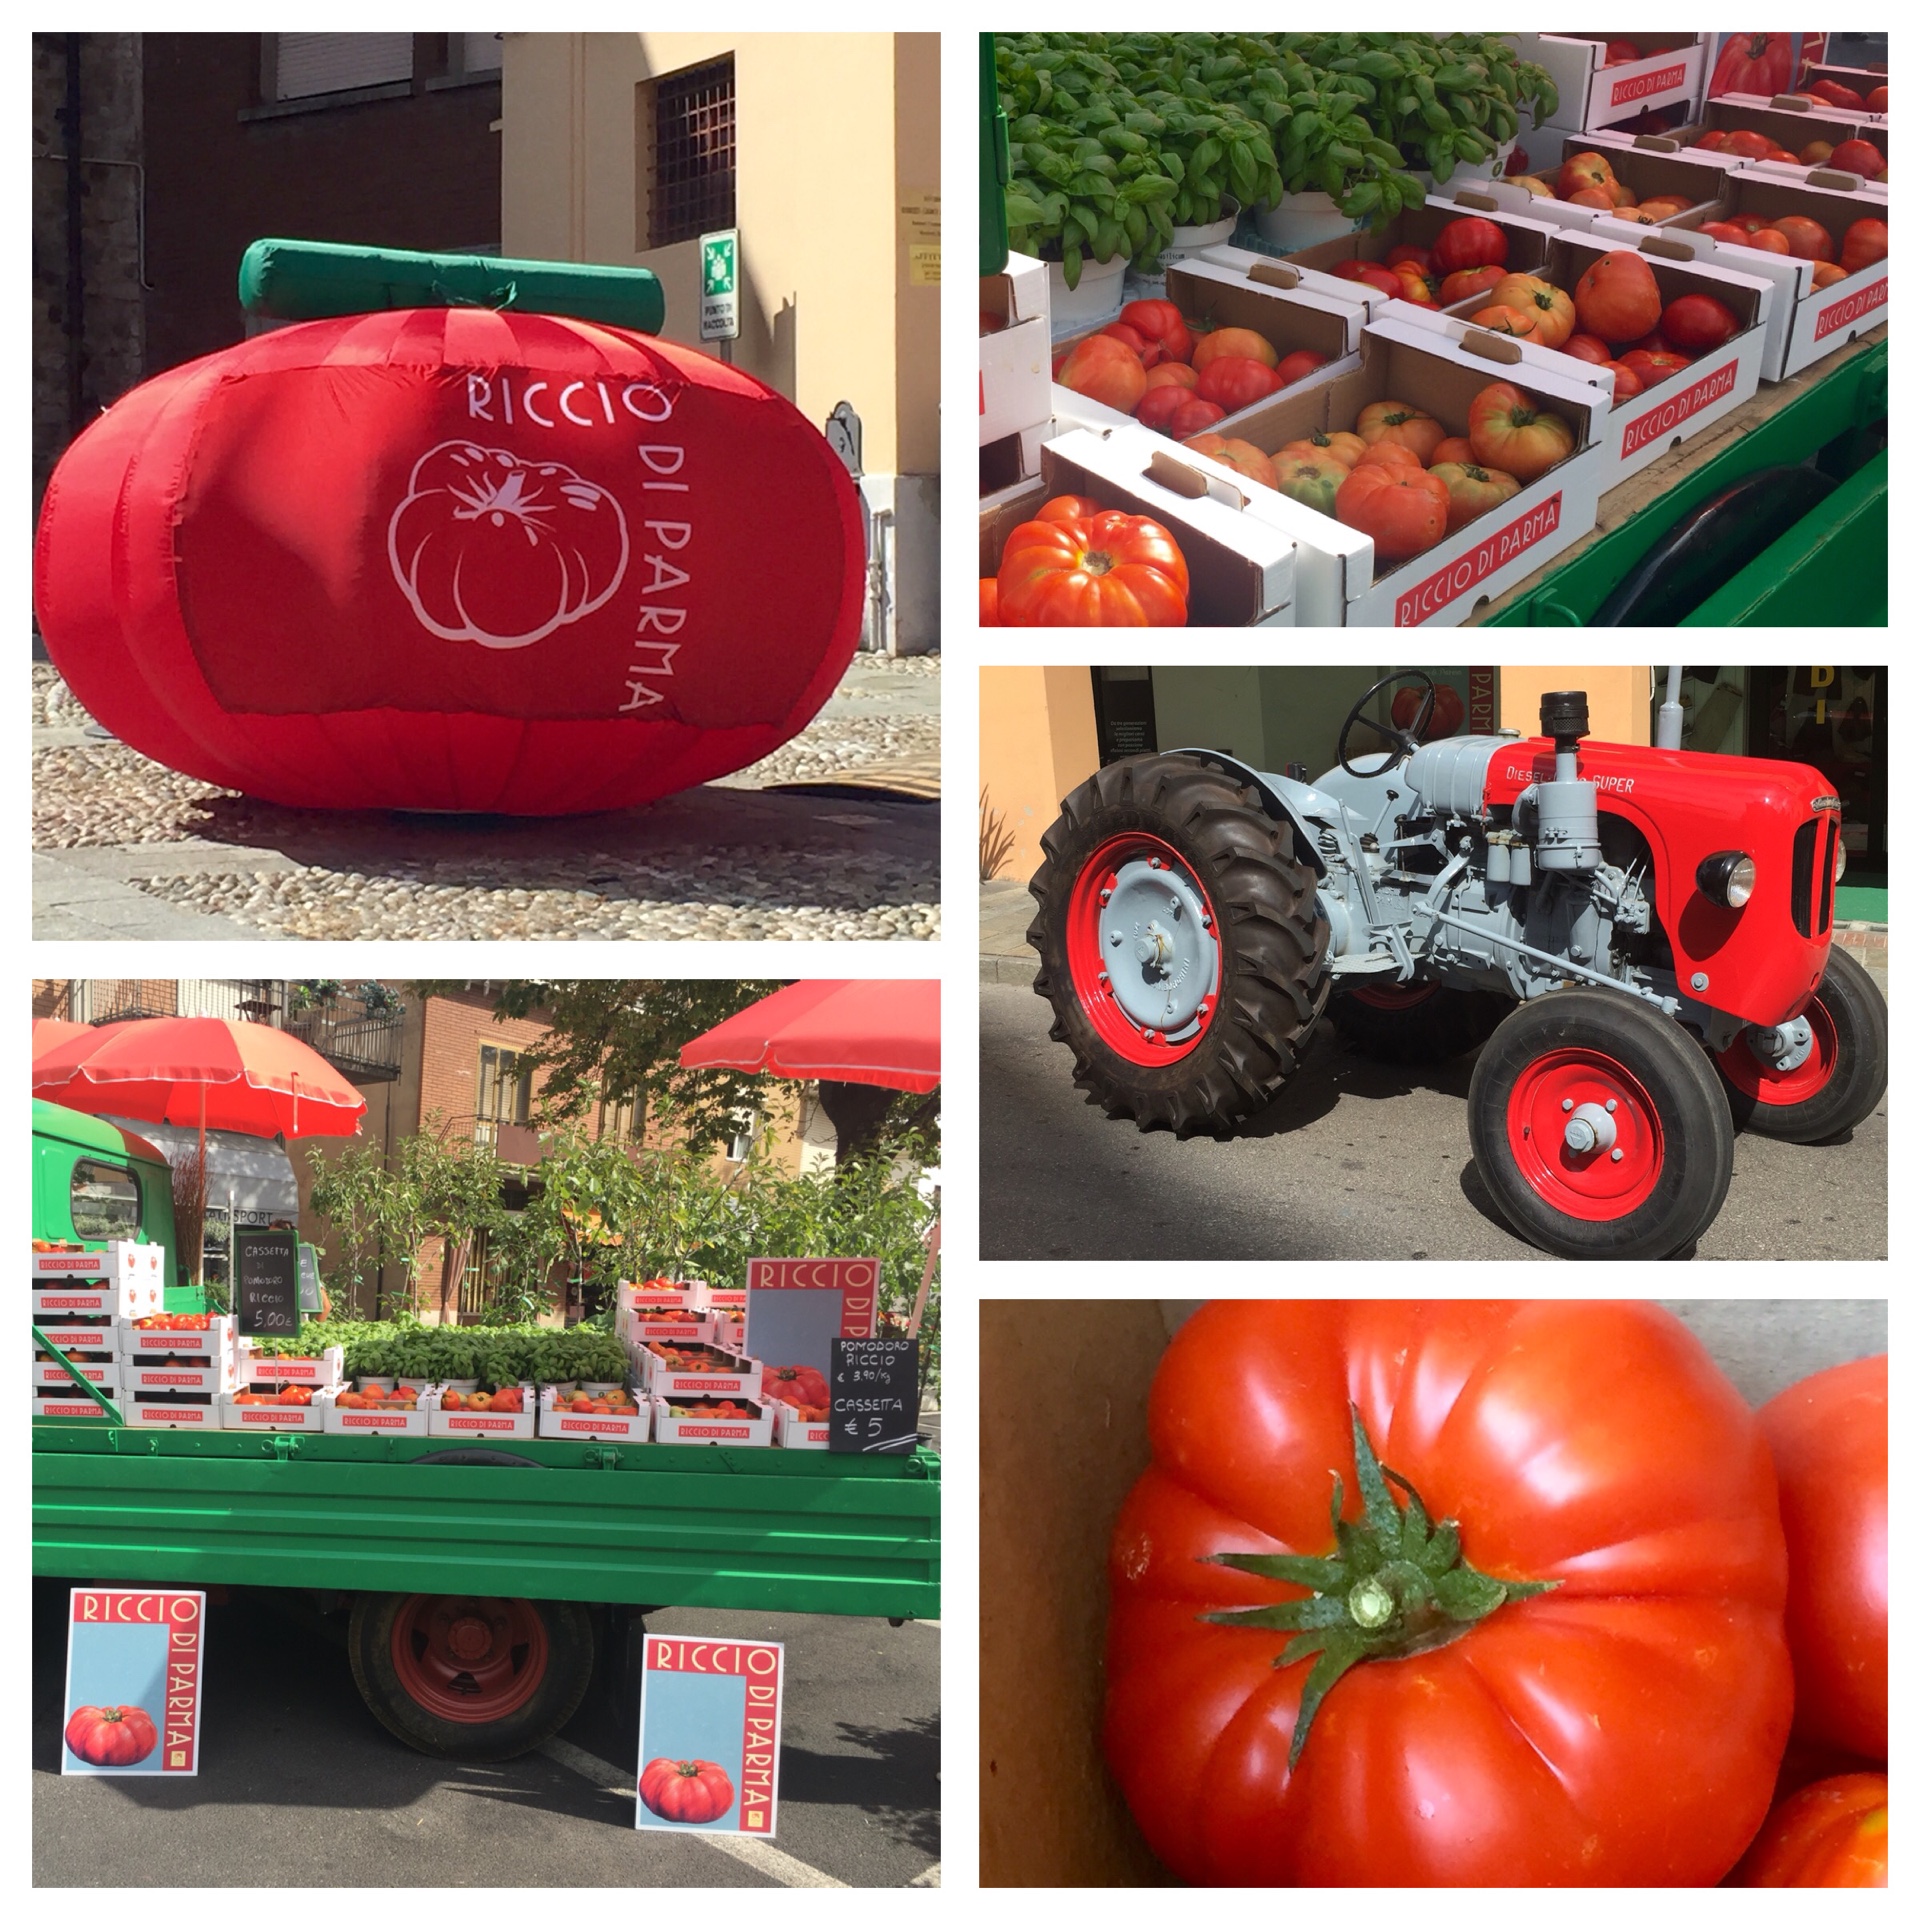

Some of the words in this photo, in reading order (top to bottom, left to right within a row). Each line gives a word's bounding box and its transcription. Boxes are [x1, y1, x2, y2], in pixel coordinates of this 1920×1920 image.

[1613, 80, 1645, 102] RICCIO
[1646, 77, 1655, 93] DI
[1656, 68, 1683, 90] PARMA
[1818, 300, 1855, 336] RICCIO
[1855, 293, 1867, 315] DI
[468, 374, 673, 428] RICCIO
[1625, 405, 1675, 452] RICCIO
[1678, 393, 1691, 419] DI
[1693, 368, 1733, 409] PARMA
[638, 445, 690, 492] DI
[1400, 561, 1472, 628] RICCIO
[1477, 543, 1495, 576] DI
[1500, 503, 1556, 561] PARMA
[618, 520, 691, 712] PARMA
[1472, 673, 1492, 730] PARM
[1593, 774, 1635, 794] SUPER
[233, 1209, 274, 1226] SPORT
[245, 1245, 289, 1258] CASSETTA
[40, 1260, 66, 1269] RICCIO
[66, 1260, 73, 1269] DI
[75, 1260, 99, 1269] PARMA
[760, 1263, 873, 1288] RICCIO
[42, 1299, 68, 1307] RICCIO
[68, 1299, 75, 1307] DI
[77, 1299, 100, 1307] PARMA
[249, 1291, 285, 1304] RICCIO
[845, 1297, 871, 1316] DI
[48, 1334, 69, 1343] ICCIO
[70, 1334, 78, 1343] DI
[79, 1335, 102, 1343] PARMA
[142, 1339, 168, 1347] RICCIO
[169, 1339, 176, 1347] DI
[177, 1339, 201, 1347] PARMA
[840, 1341, 909, 1352] POMODORO
[846, 1353, 896, 1367] RICCIO
[143, 1375, 168, 1383] RICCIO
[178, 1376, 202, 1384] PARMA
[675, 1381, 703, 1389] RICCIO
[704, 1381, 712, 1389] DI
[713, 1381, 739, 1389] PARMA
[45, 1406, 70, 1414] RICCIO
[71, 1406, 78, 1414] DI
[79, 1407, 102, 1415] PARMA
[834, 1398, 903, 1412] CASSETTA
[144, 1411, 169, 1419] RICCIO
[170, 1411, 177, 1419] DI
[178, 1412, 201, 1420] PARMA
[243, 1413, 270, 1421] RICCIO
[279, 1414, 303, 1422] PARMA
[344, 1417, 371, 1425] RICCIO
[372, 1418, 380, 1426] DI
[380, 1418, 406, 1426] PARMA
[450, 1420, 478, 1428] RICCIO
[488, 1421, 513, 1429] PARMA
[563, 1421, 591, 1430] RICCIO
[592, 1423, 600, 1431] DI
[601, 1423, 627, 1432] PARMA
[867, 1417, 883, 1438] 5
[680, 1428, 710, 1436] RICCIO
[711, 1428, 719, 1436] DI
[720, 1428, 748, 1437] PARMA
[810, 1432, 829, 1440] RICC
[83, 1595, 199, 1623] RICCIO
[171, 1632, 197, 1653] DI
[656, 1641, 776, 1675] RICCIO
[748, 1685, 775, 1708] DI
[166, 1663, 196, 1748] PARMA
[743, 1717, 774, 1806] PARMA
